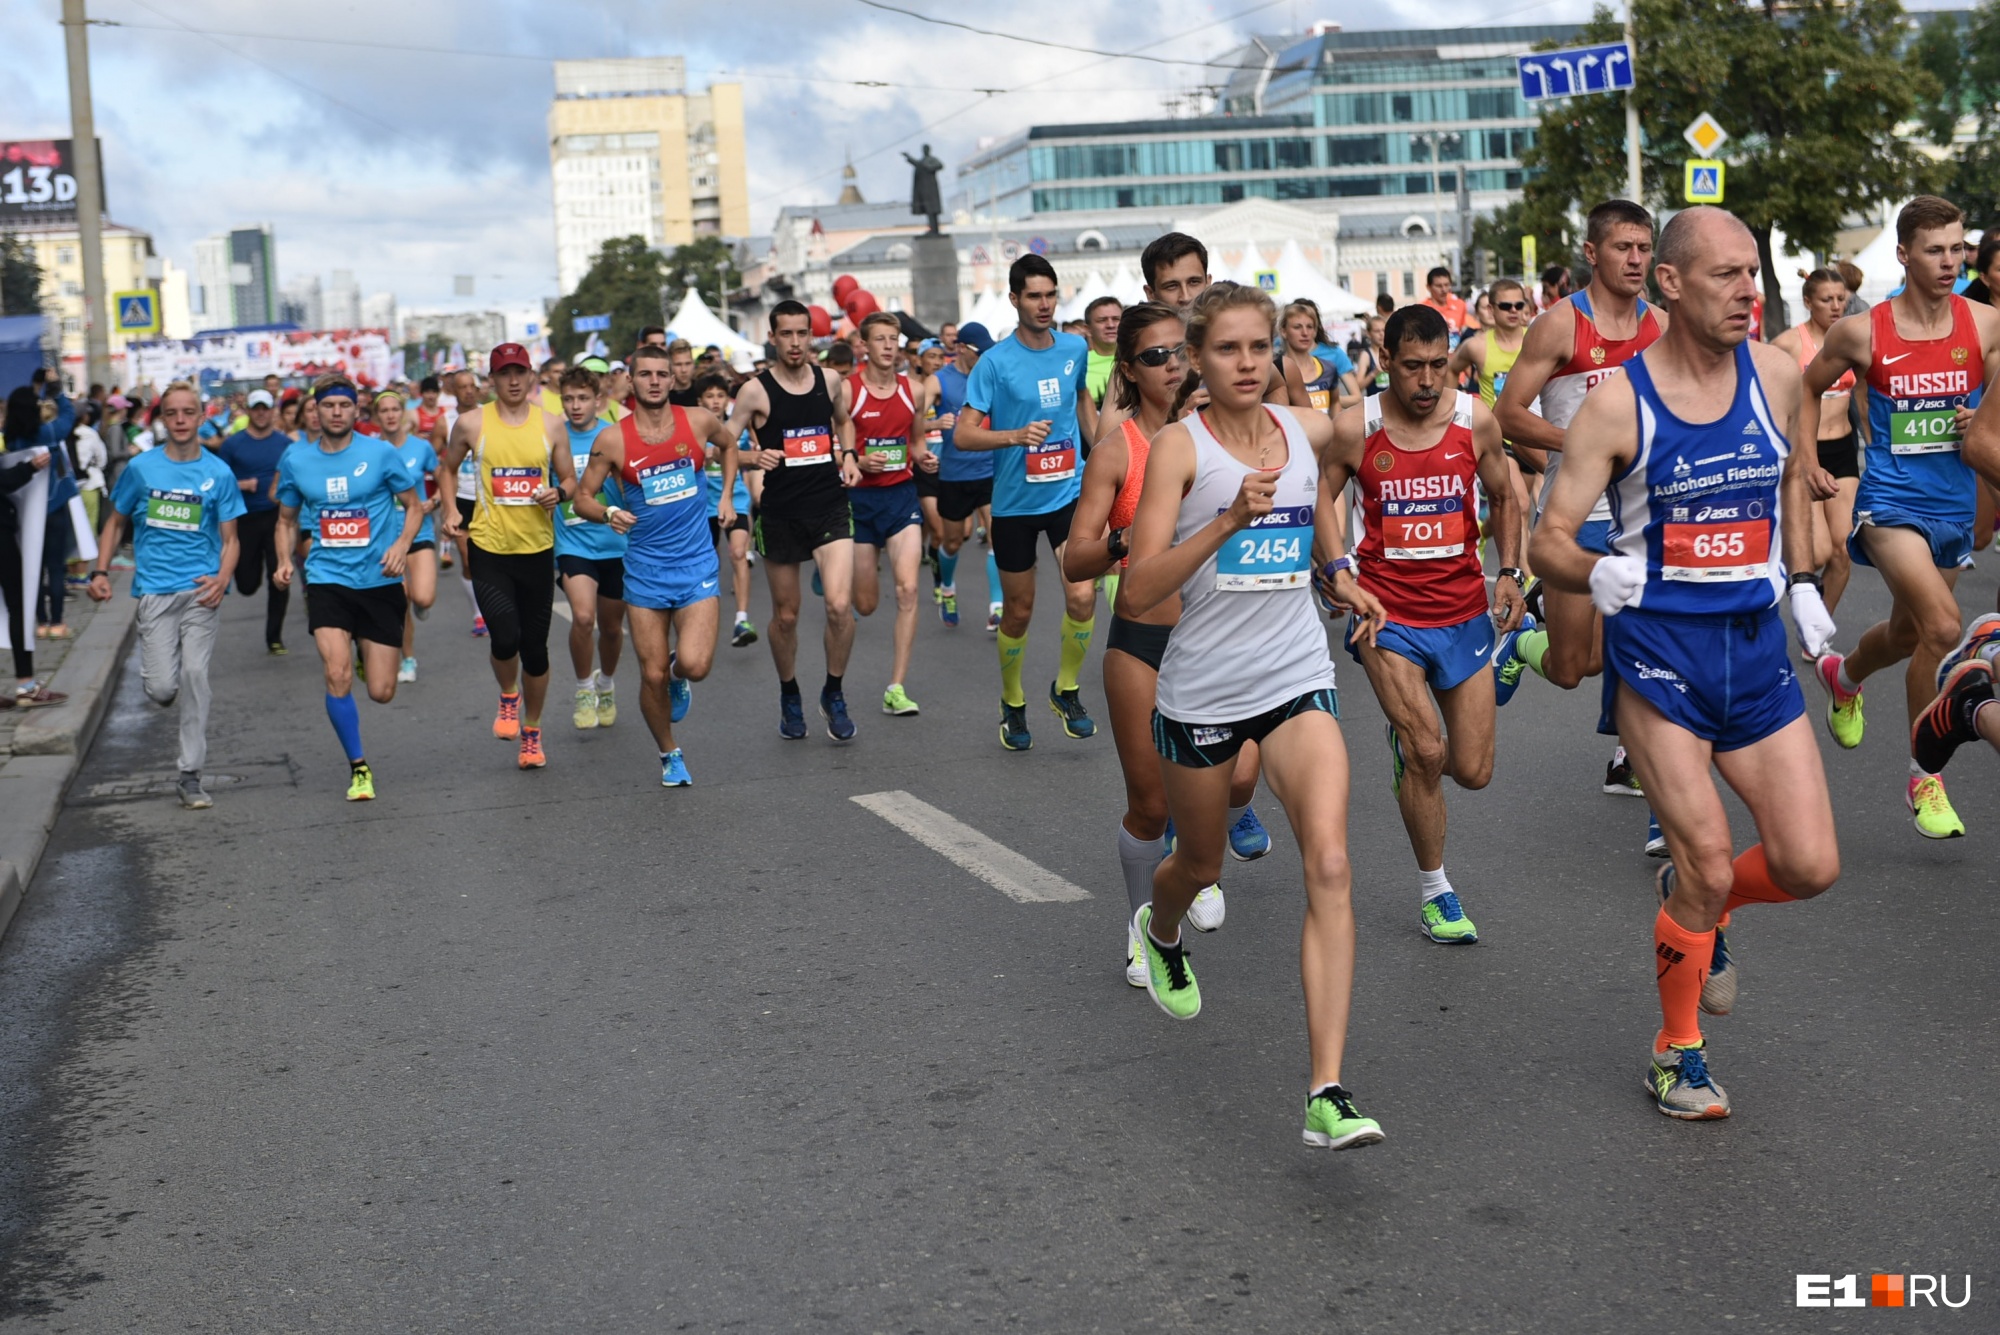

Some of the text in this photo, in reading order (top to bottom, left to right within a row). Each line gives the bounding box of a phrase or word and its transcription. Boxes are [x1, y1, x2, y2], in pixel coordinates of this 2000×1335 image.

[0, 166, 77, 204] 13D
[1890, 370, 1967, 396] RUSSIA
[1924, 400, 1946, 409] asics
[1904, 416, 1957, 437] 4102
[801, 440, 817, 453] 86
[876, 449, 902, 461] 069
[1040, 455, 1064, 470] 637
[503, 481, 531, 493] 340
[652, 474, 686, 493] 2236
[1380, 474, 1465, 502] RUSSIA
[1654, 464, 1778, 497] Autohaus Fiebrich
[156, 504, 191, 520] 4948
[1415, 503, 1438, 513] asics
[1709, 507, 1739, 519] asics
[1262, 512, 1291, 524] asics
[328, 522, 359, 536] 600
[1401, 521, 1443, 541] 701
[1239, 537, 1301, 564] 2454
[1693, 532, 1745, 558] 655
